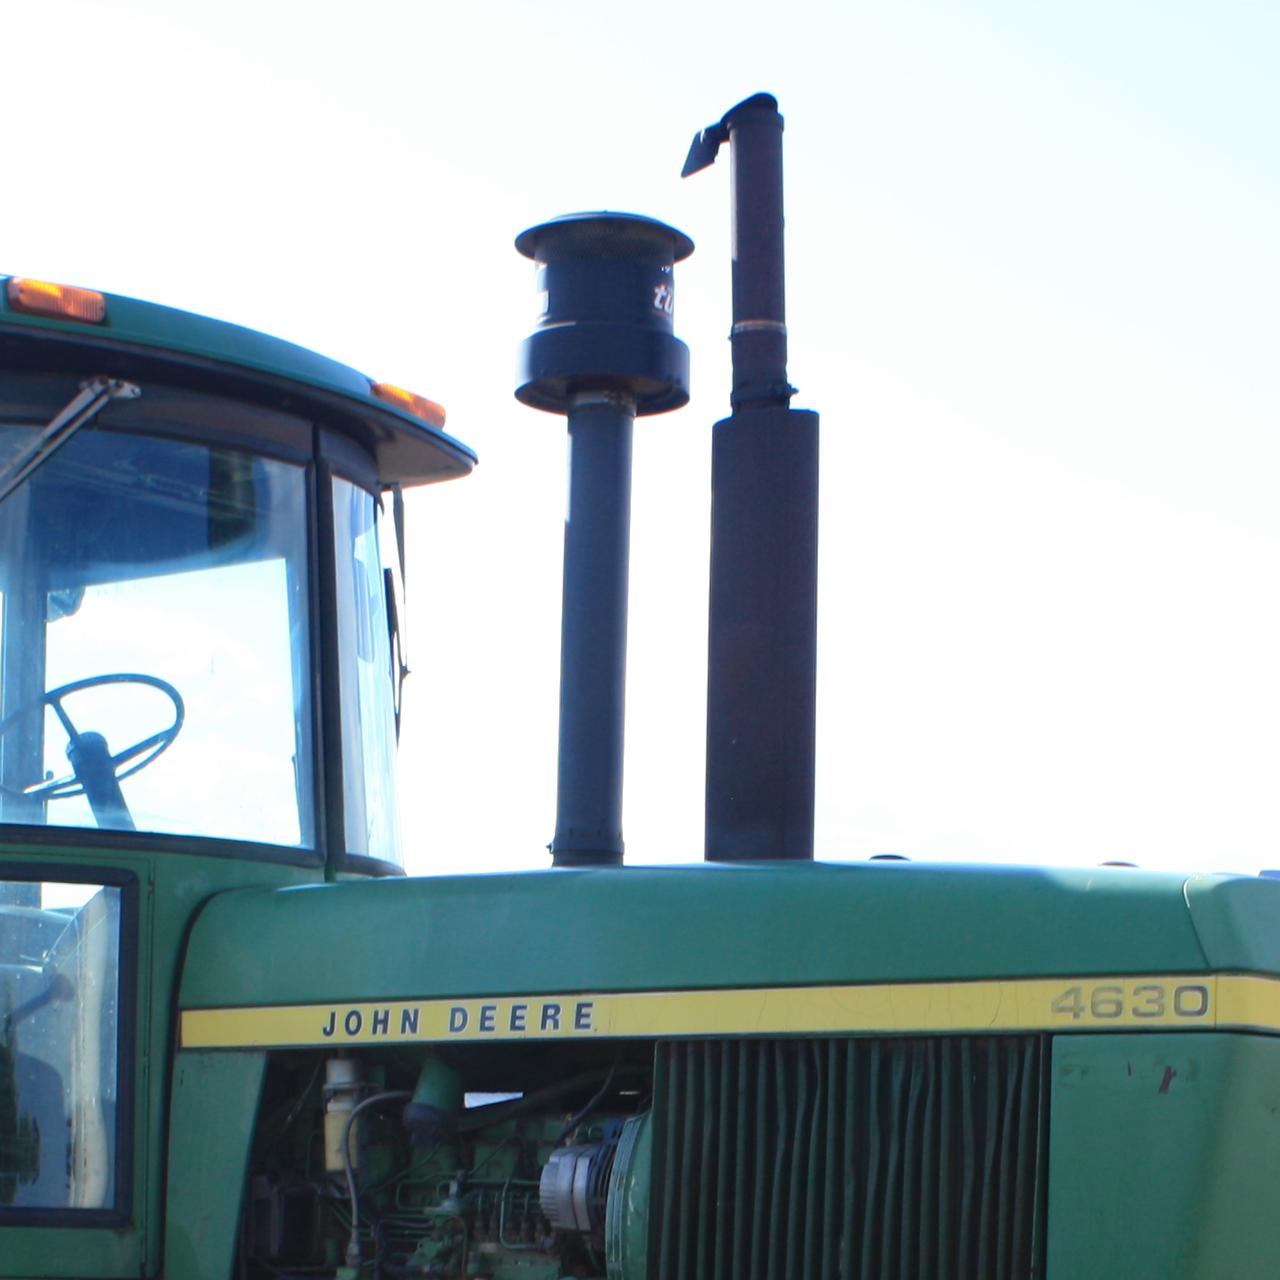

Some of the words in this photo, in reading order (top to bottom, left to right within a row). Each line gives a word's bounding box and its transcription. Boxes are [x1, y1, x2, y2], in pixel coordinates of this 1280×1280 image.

[322, 1008, 420, 1037] JOHN
[448, 1002, 594, 1033] DEERE
[1051, 984, 1209, 1020] 4630
